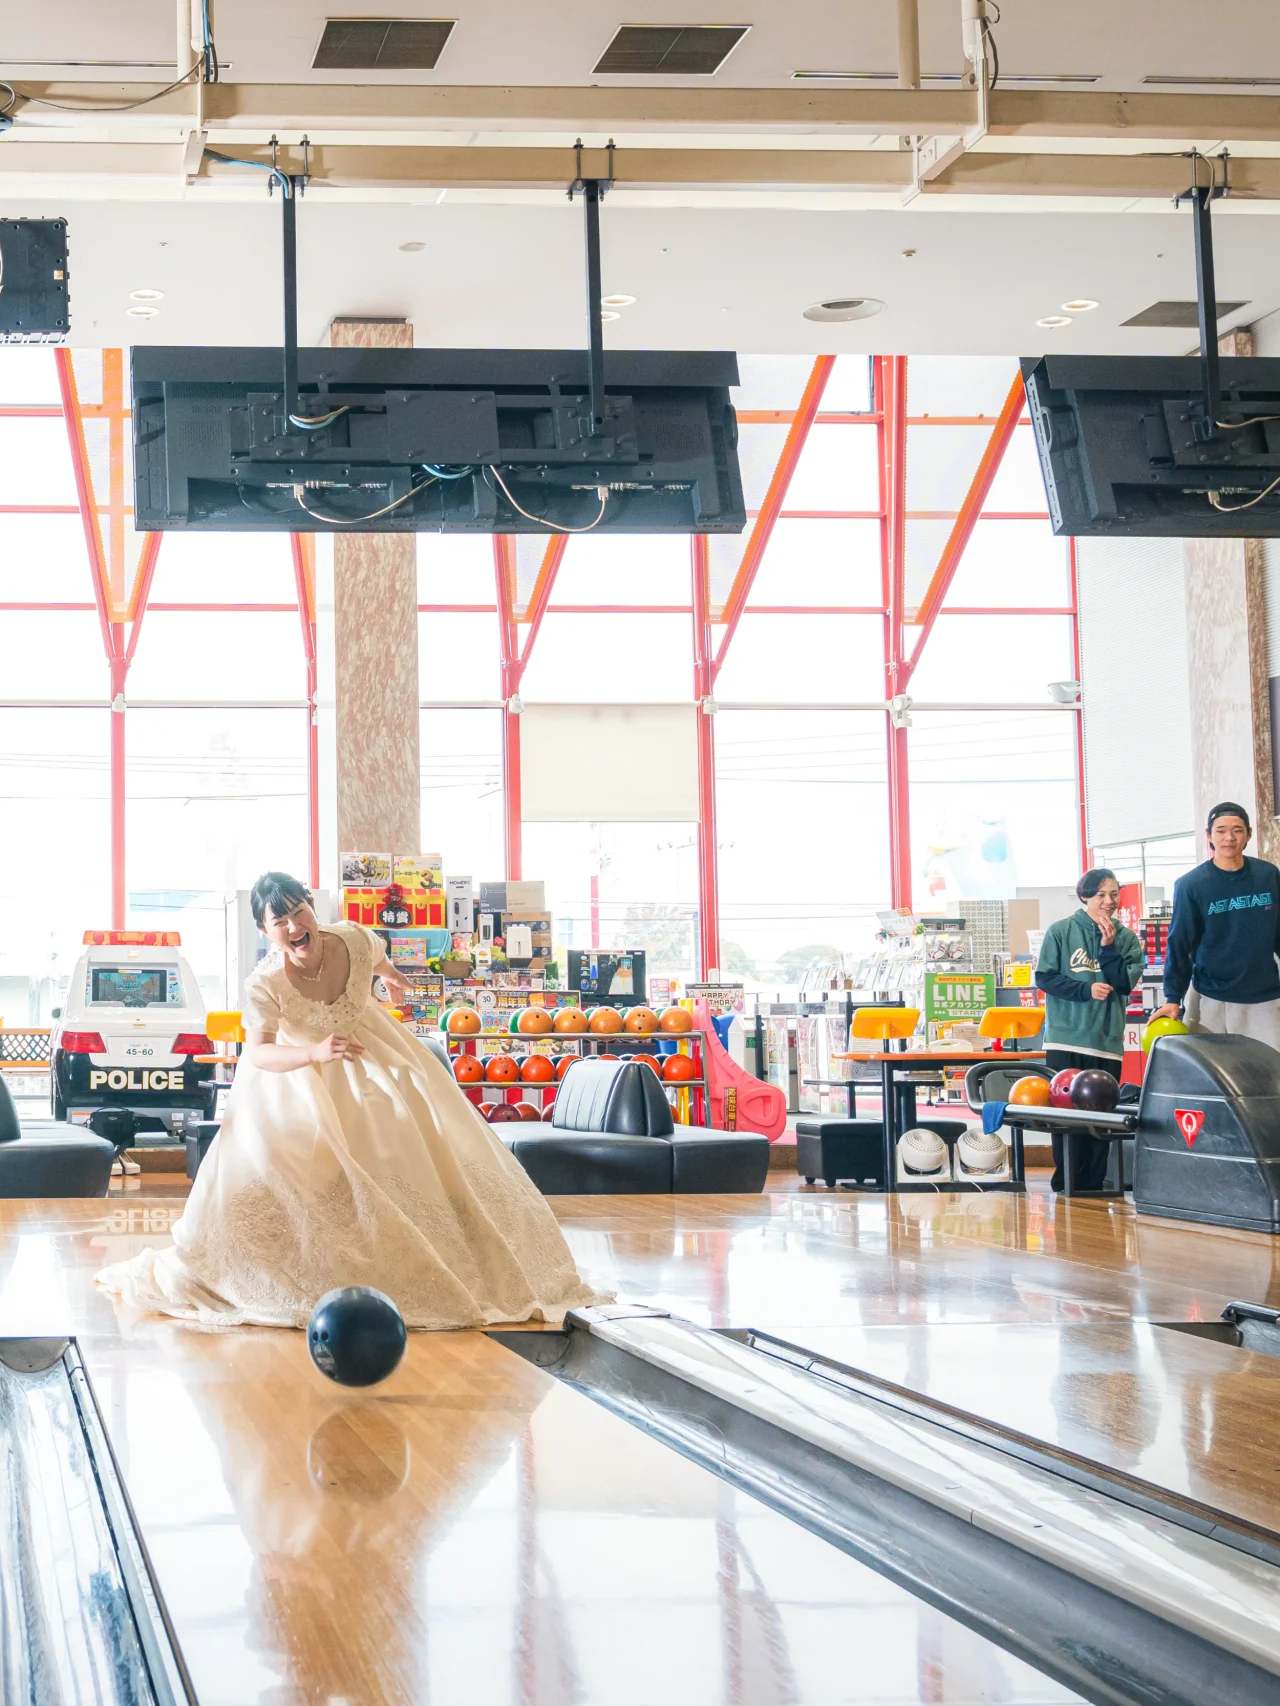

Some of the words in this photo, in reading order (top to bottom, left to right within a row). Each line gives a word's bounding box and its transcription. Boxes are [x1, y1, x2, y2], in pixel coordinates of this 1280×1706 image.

[933, 984, 987, 1002] LINE
[933, 1001, 987, 1009] 公式アカウント
[125, 1048, 154, 1056] 45-60
[89, 1069, 185, 1091] POLICE
